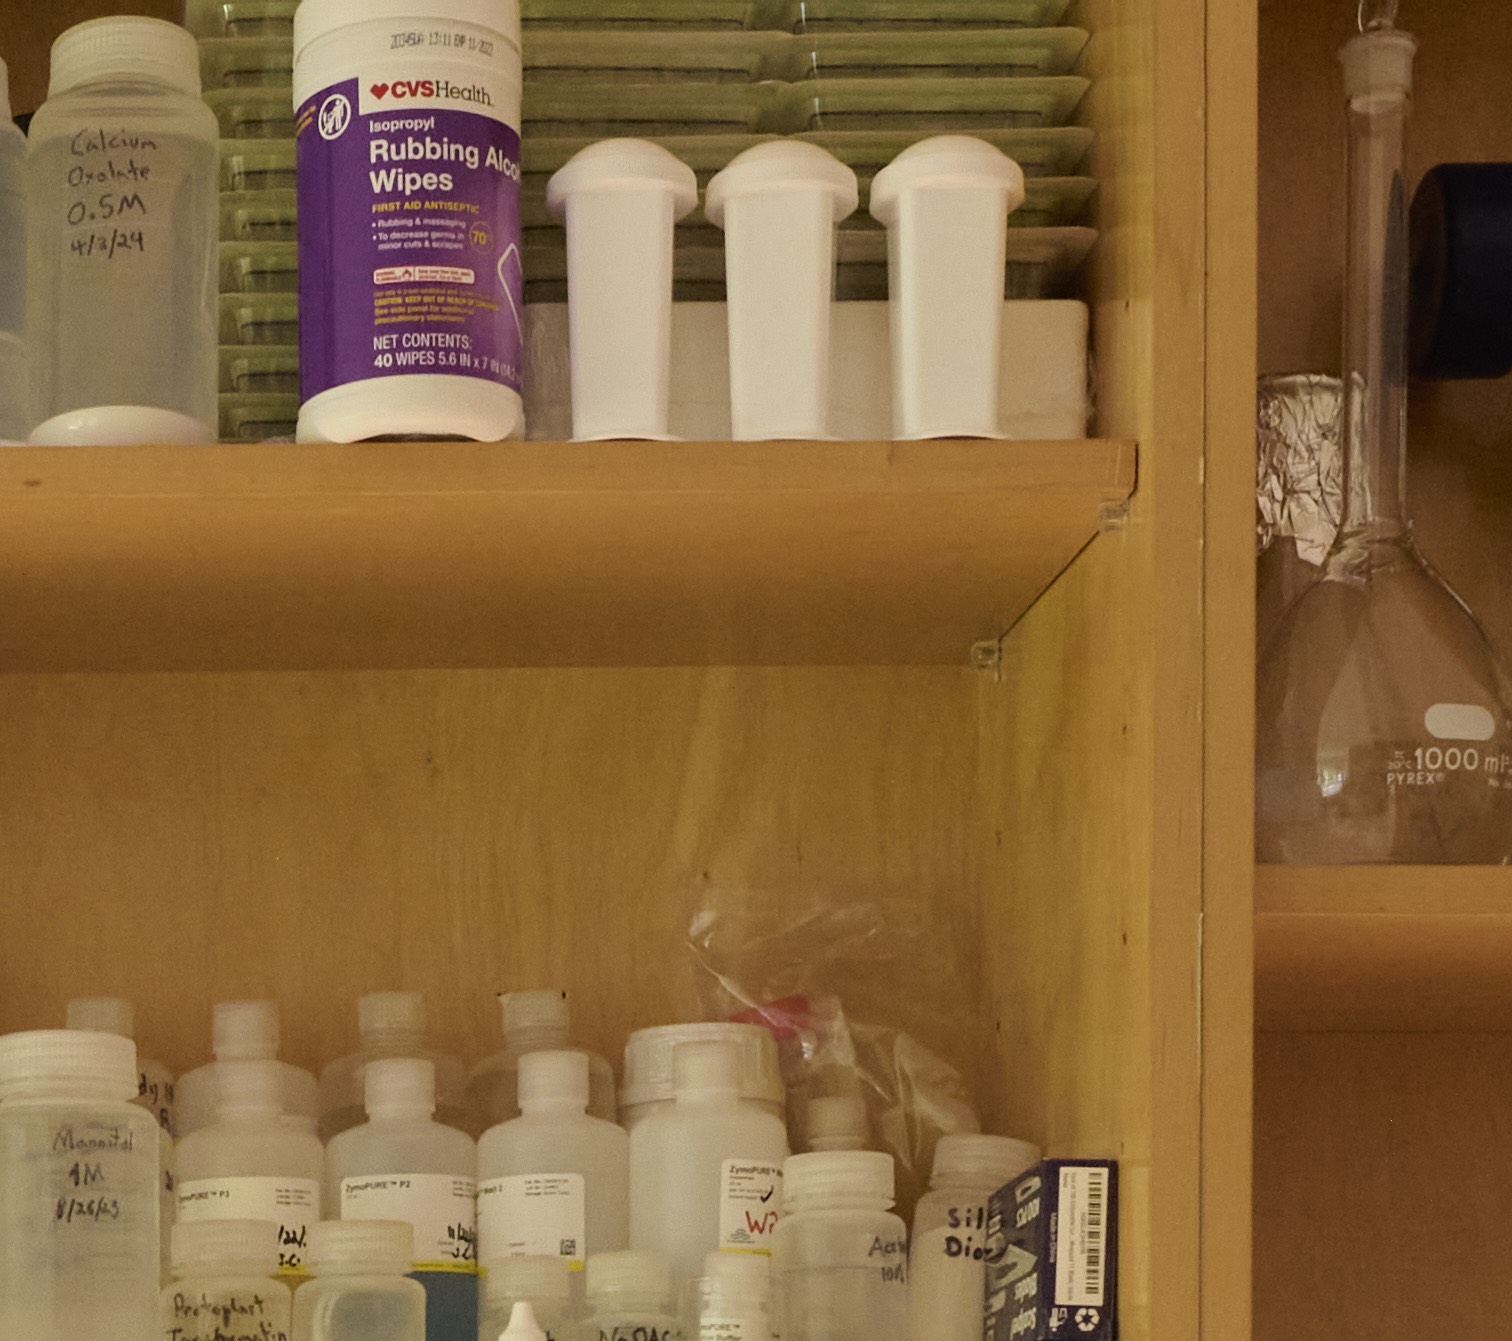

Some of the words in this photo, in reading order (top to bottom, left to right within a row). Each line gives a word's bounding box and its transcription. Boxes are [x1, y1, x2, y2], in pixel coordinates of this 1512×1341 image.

[370, 117, 435, 133] Isopropyl
[70, 129, 157, 156] Calcium
[370, 136, 479, 169] Rubbing
[67, 161, 150, 186] Oxalate
[370, 169, 453, 195] Wipes
[67, 194, 147, 225] 0.5M
[372, 202, 400, 213] FIRST
[404, 201, 421, 211] AID
[424, 201, 479, 213] ANTISEPTIC
[374, 335, 398, 350] NET
[402, 333, 472, 349] CONTENTS:
[374, 354, 393, 367] 40
[396, 352, 435, 365] WIPES
[439, 352, 456, 365] 5.6
[460, 354, 470, 366] IN
[483, 359, 488, 369] 7
[1386, 773, 1435, 784] PYREX
[69, 1163, 104, 1185] 1M
